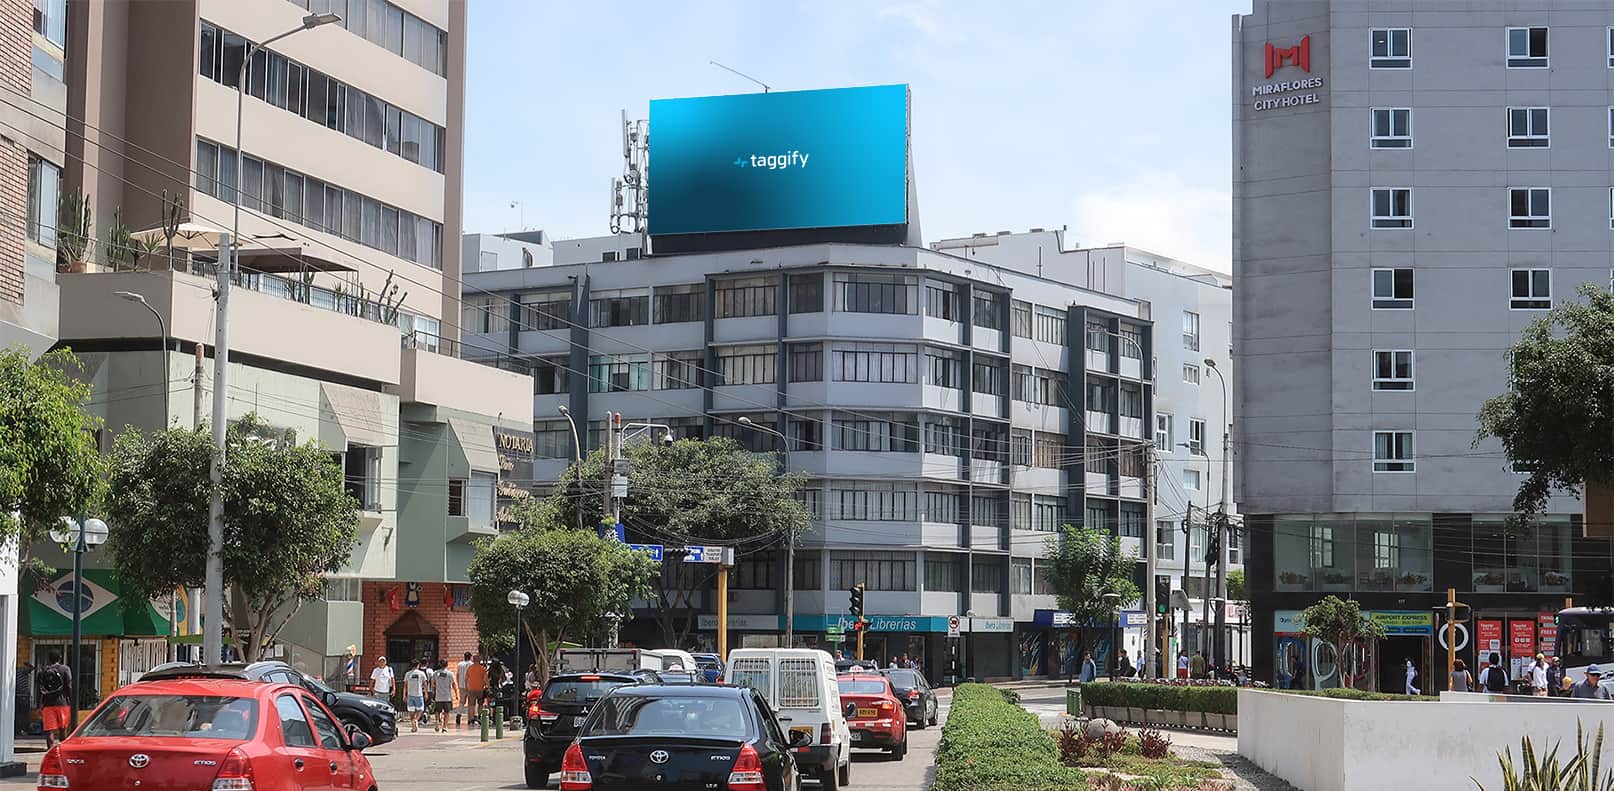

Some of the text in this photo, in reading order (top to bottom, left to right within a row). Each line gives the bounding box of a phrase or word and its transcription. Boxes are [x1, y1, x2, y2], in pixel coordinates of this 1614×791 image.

[1252, 77, 1322, 96] MIRAFLORES
[1254, 93, 1320, 111] CITY HOTEL
[750, 150, 809, 170] taggify
[870, 617, 917, 630] Librerías
